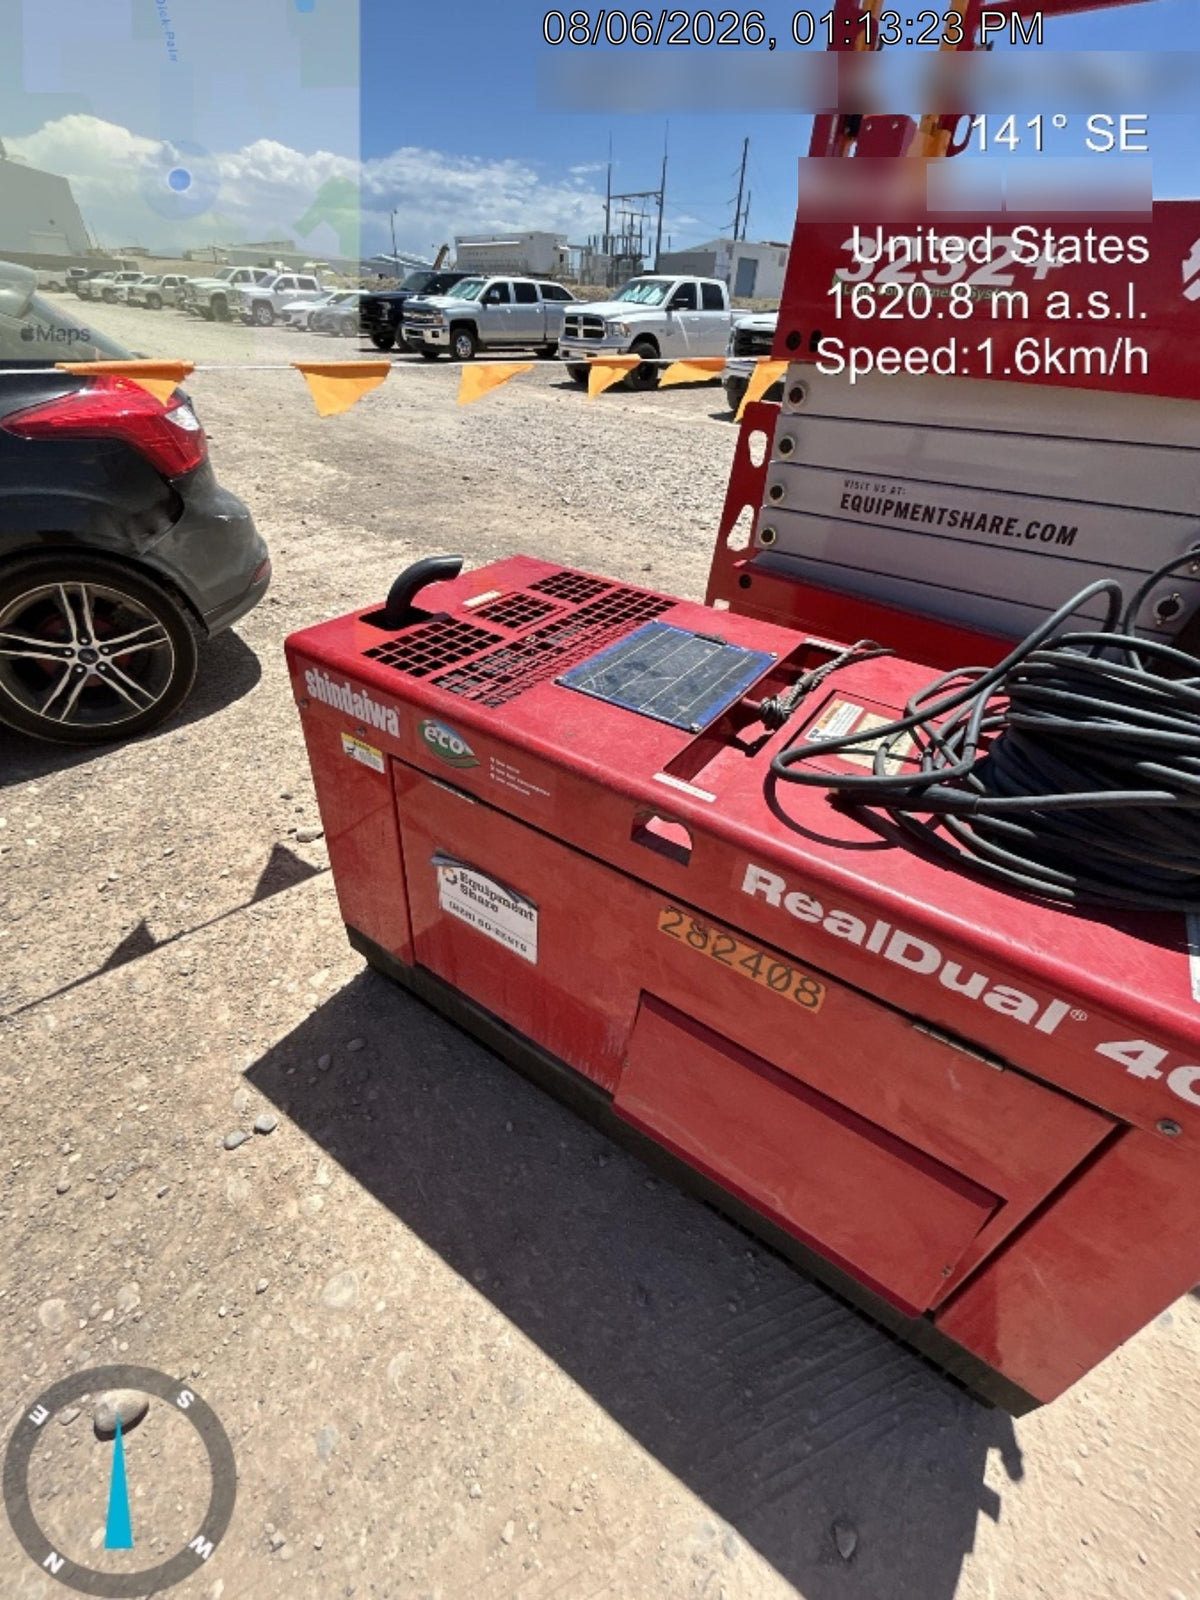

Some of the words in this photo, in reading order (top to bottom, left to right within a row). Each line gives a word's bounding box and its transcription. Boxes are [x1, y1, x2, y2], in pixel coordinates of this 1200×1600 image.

[840, 493, 1079, 546] EQUIPMENTSHARE.COM
[304, 667, 400, 738] shindaiwa
[459, 870, 535, 921] Equipment
[459, 883, 499, 913] Share
[658, 905, 822, 1008] 282408
